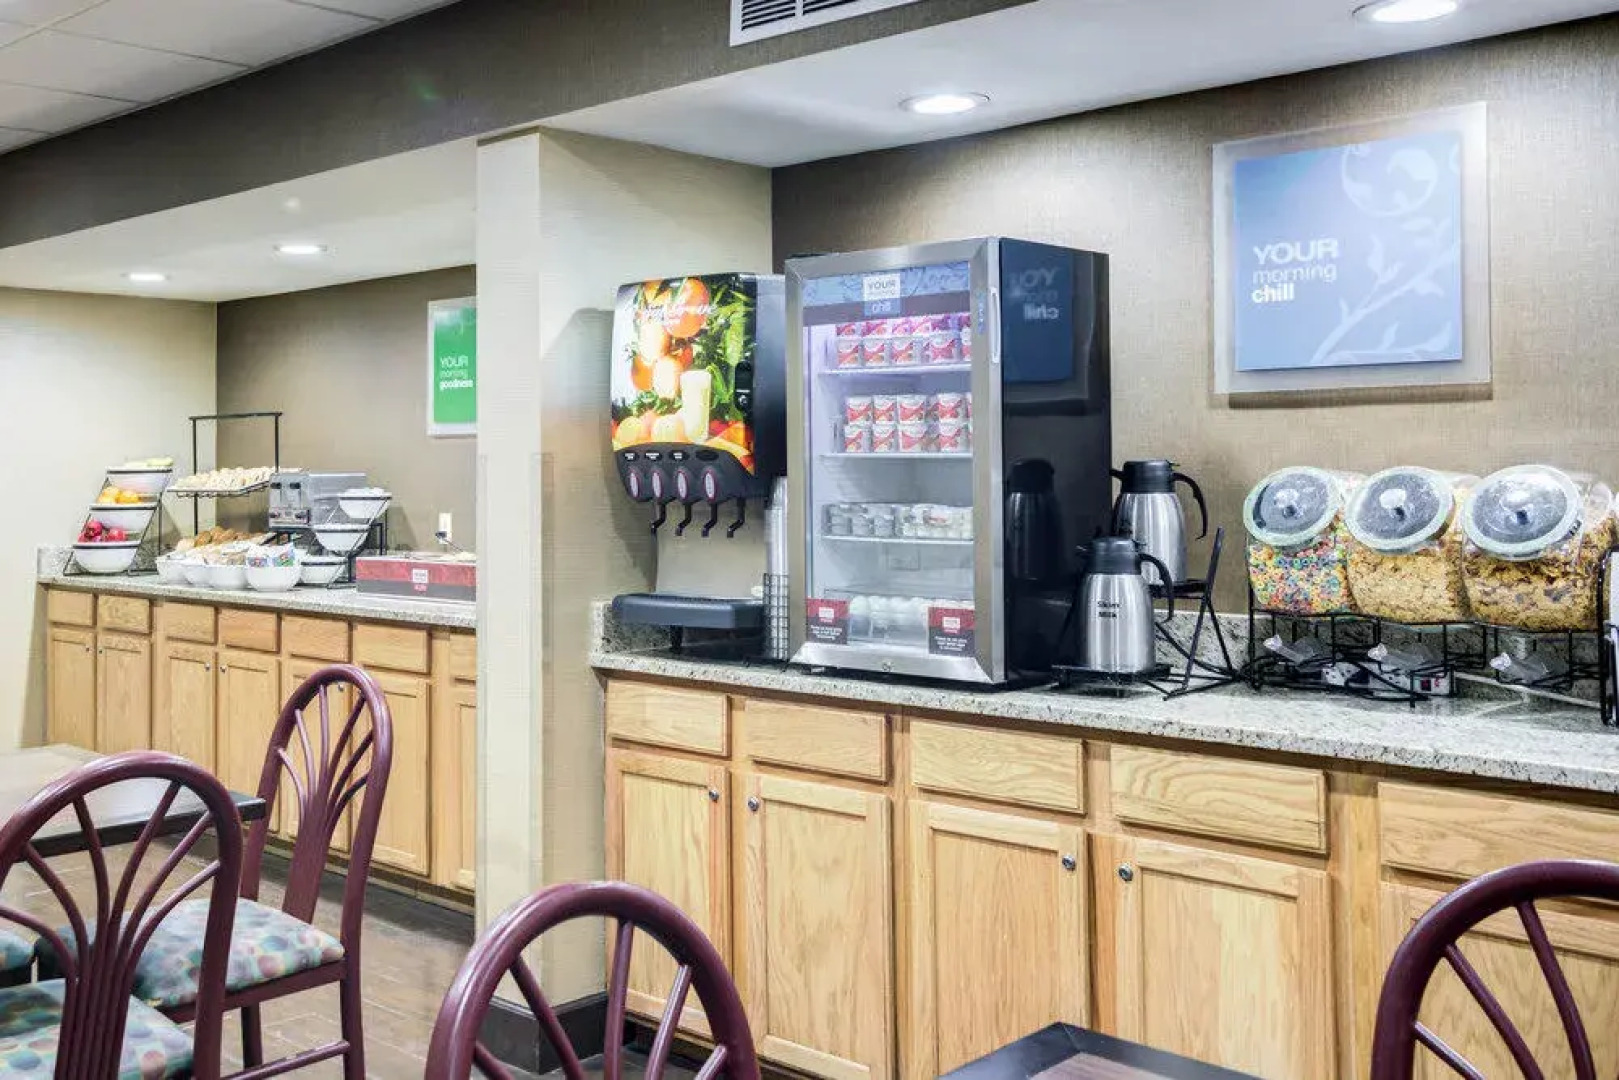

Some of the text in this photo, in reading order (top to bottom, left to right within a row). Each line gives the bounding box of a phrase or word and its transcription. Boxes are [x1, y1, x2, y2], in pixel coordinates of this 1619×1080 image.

[1252, 238, 1339, 265] YOUR
[1252, 264, 1337, 283] morning
[1252, 282, 1295, 304] chill
[440, 355, 469, 369] YOUR
[440, 379, 474, 391] goodness
